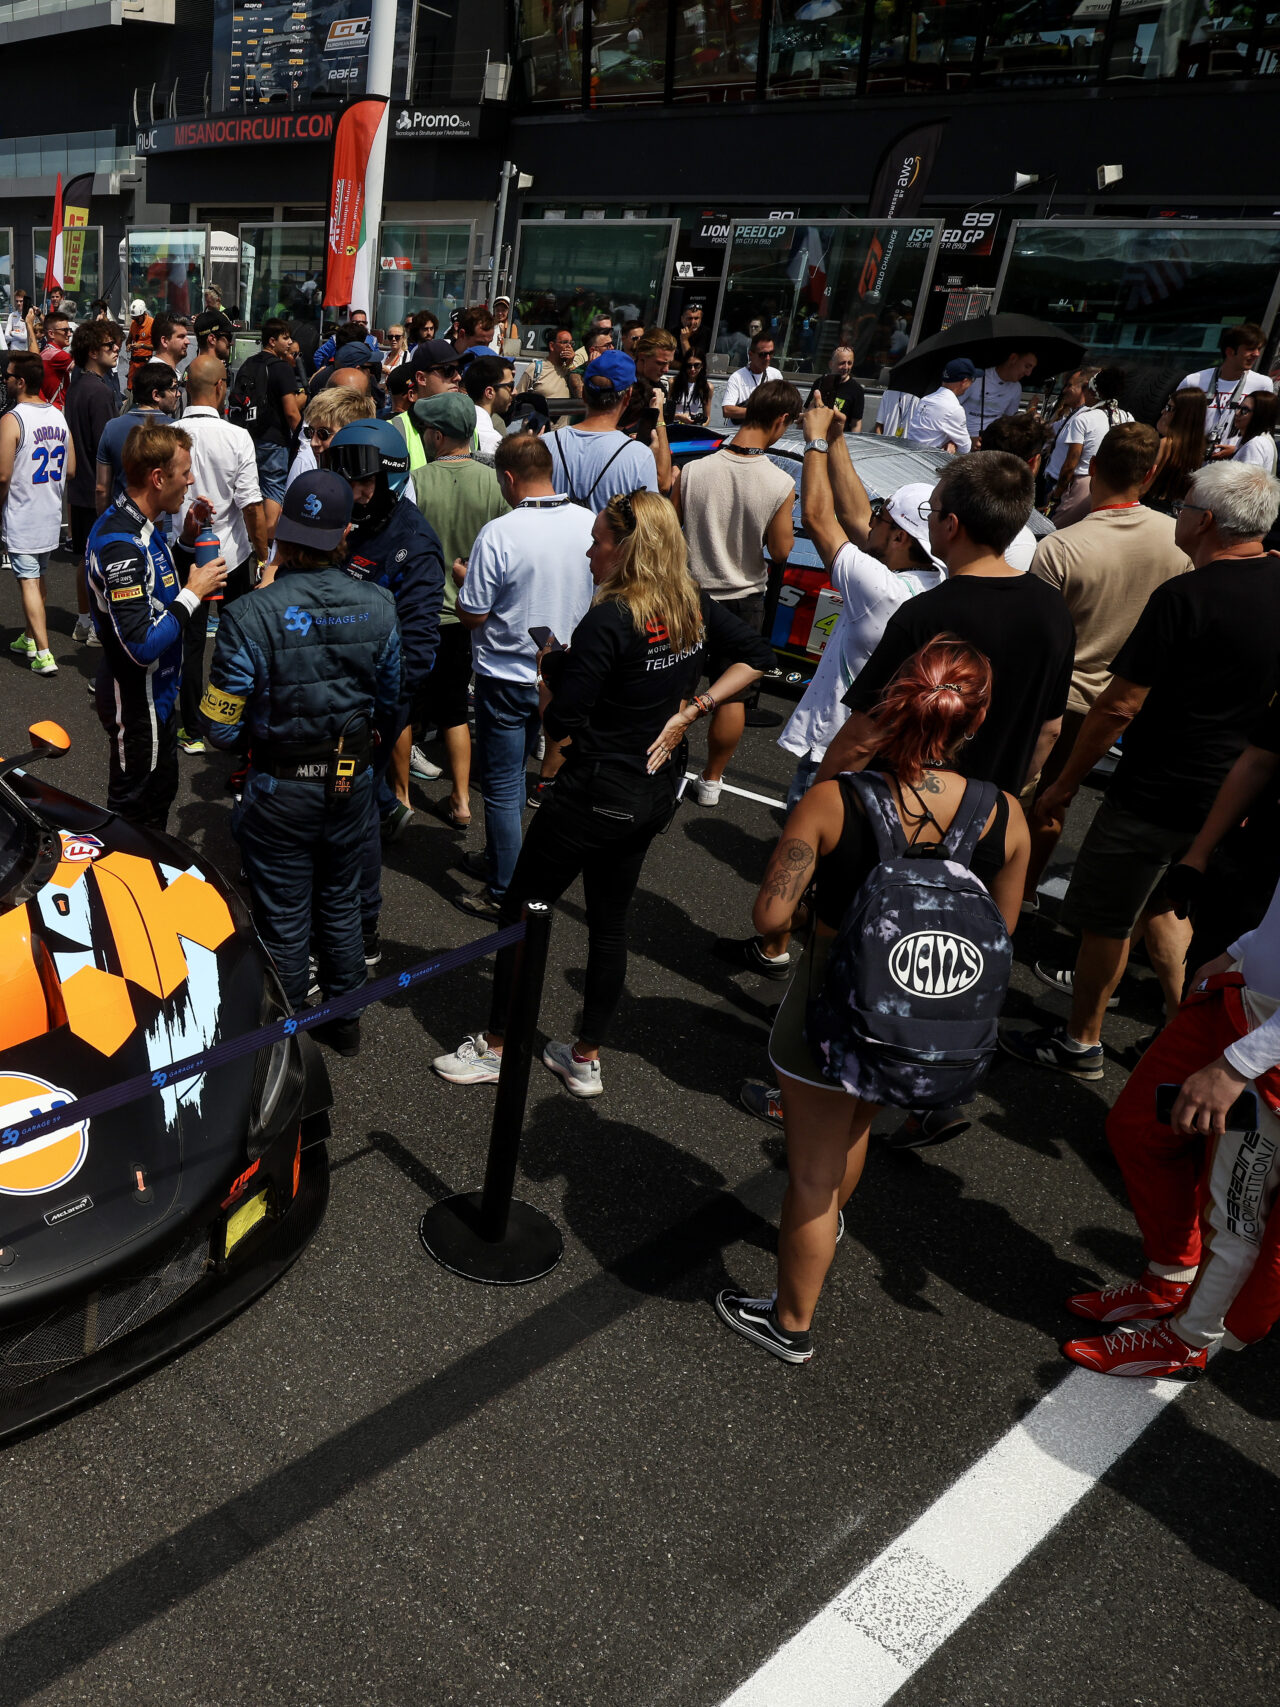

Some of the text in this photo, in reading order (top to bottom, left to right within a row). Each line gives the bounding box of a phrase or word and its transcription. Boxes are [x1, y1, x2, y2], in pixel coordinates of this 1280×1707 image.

[413, 111, 460, 128] Promo
[898, 157, 914, 187] aws
[963, 213, 995, 226] 89
[701, 225, 786, 238] LIONPEED GP
[963, 231, 984, 243] GP
[824, 286, 832, 296] 43
[527, 330, 536, 349] 2
[32, 426, 67, 445] JORDAN
[32, 445, 66, 485] 23
[304, 494, 323, 516] 59
[113, 588, 141, 599] PIRELLI
[283, 606, 369, 637] 59 GARAGE 59
[645, 640, 703, 672] TELEVISION
[152, 1071, 167, 1087] 59
[168, 1064, 195, 1078] GARAGE
[1, 1127, 20, 1145] 59
[21, 1119, 51, 1135] GARAGE
[1226, 1132, 1261, 1237] PARADINE
[1242, 1152, 1273, 1234] COMPETITION
[51, 1202, 86, 1221] McLaren
